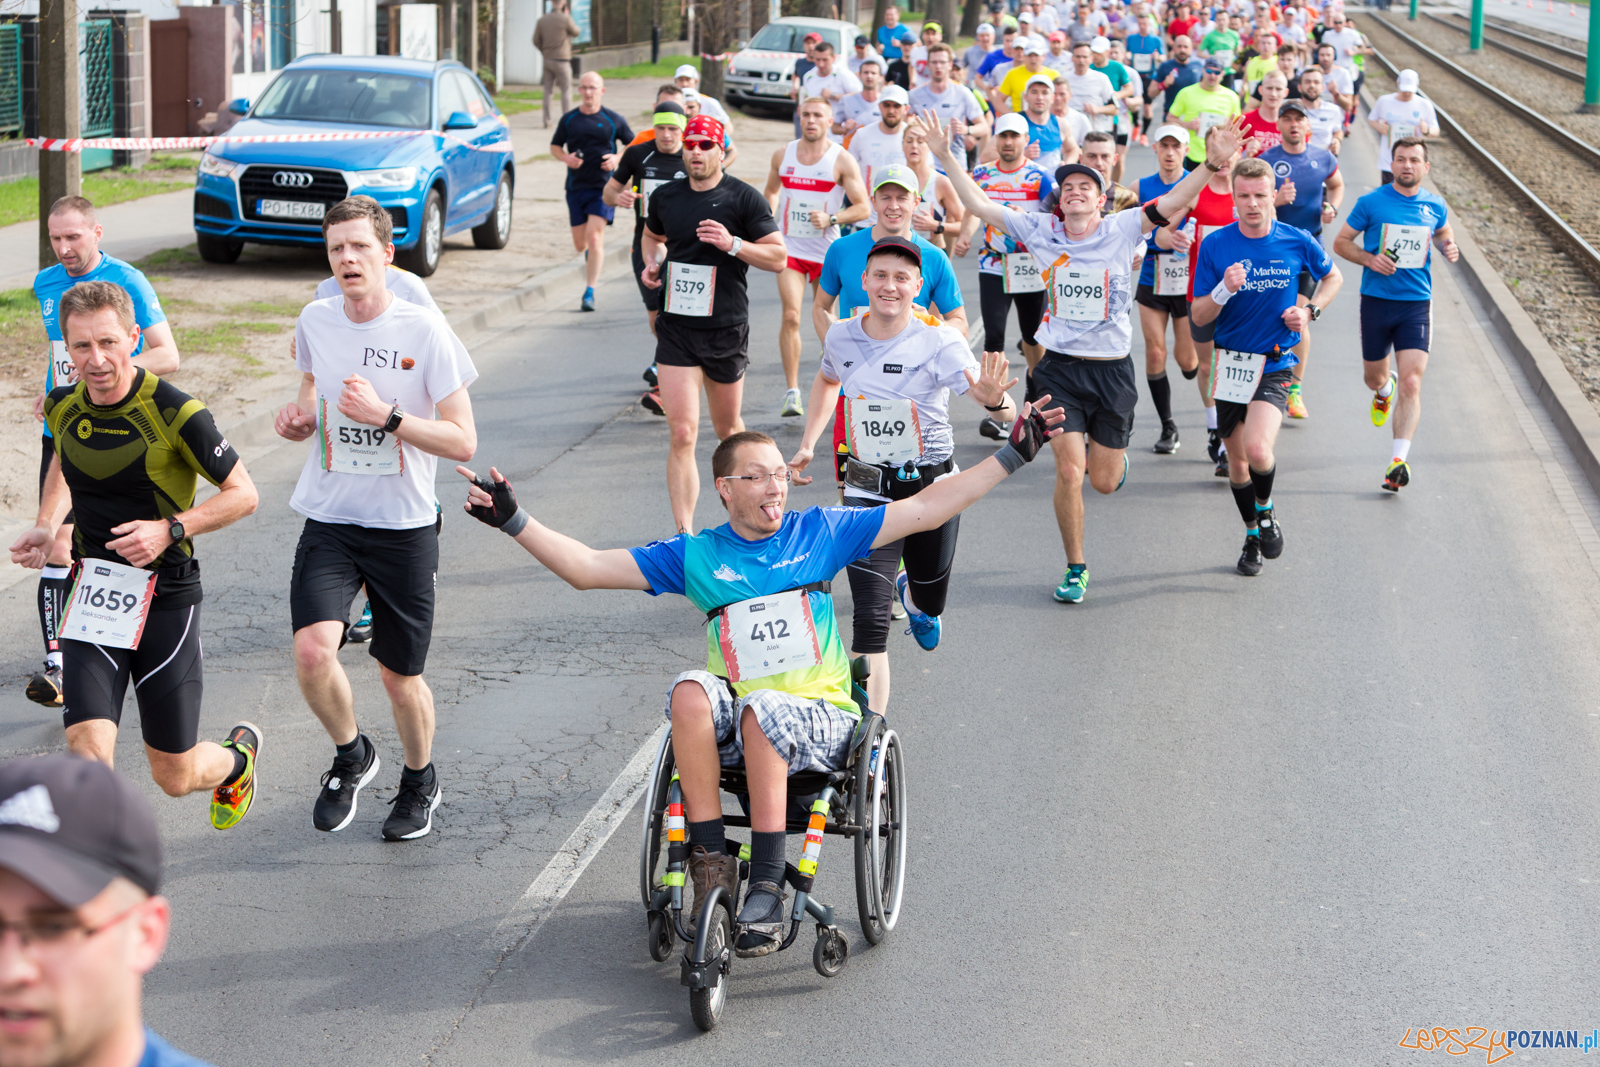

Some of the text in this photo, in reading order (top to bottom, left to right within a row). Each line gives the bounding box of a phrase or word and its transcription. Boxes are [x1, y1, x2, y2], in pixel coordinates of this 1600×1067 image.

[789, 177, 816, 185] POLSKA
[263, 201, 280, 213] PO
[286, 203, 322, 216] 1EX86
[1393, 239, 1421, 251] 4716
[1164, 266, 1190, 278] 9628
[1253, 266, 1290, 277] Markowi
[675, 279, 705, 294] 5379
[1058, 283, 1102, 299] 10998
[362, 347, 399, 369] PSI
[1225, 366, 1255, 383] 11113
[862, 420, 906, 437] 1849
[339, 426, 386, 447] 5319
[349, 447, 378, 455] Sebastian
[78, 584, 138, 614] 11659
[81, 610, 117, 622] Aleksander
[750, 618, 790, 642] 412
